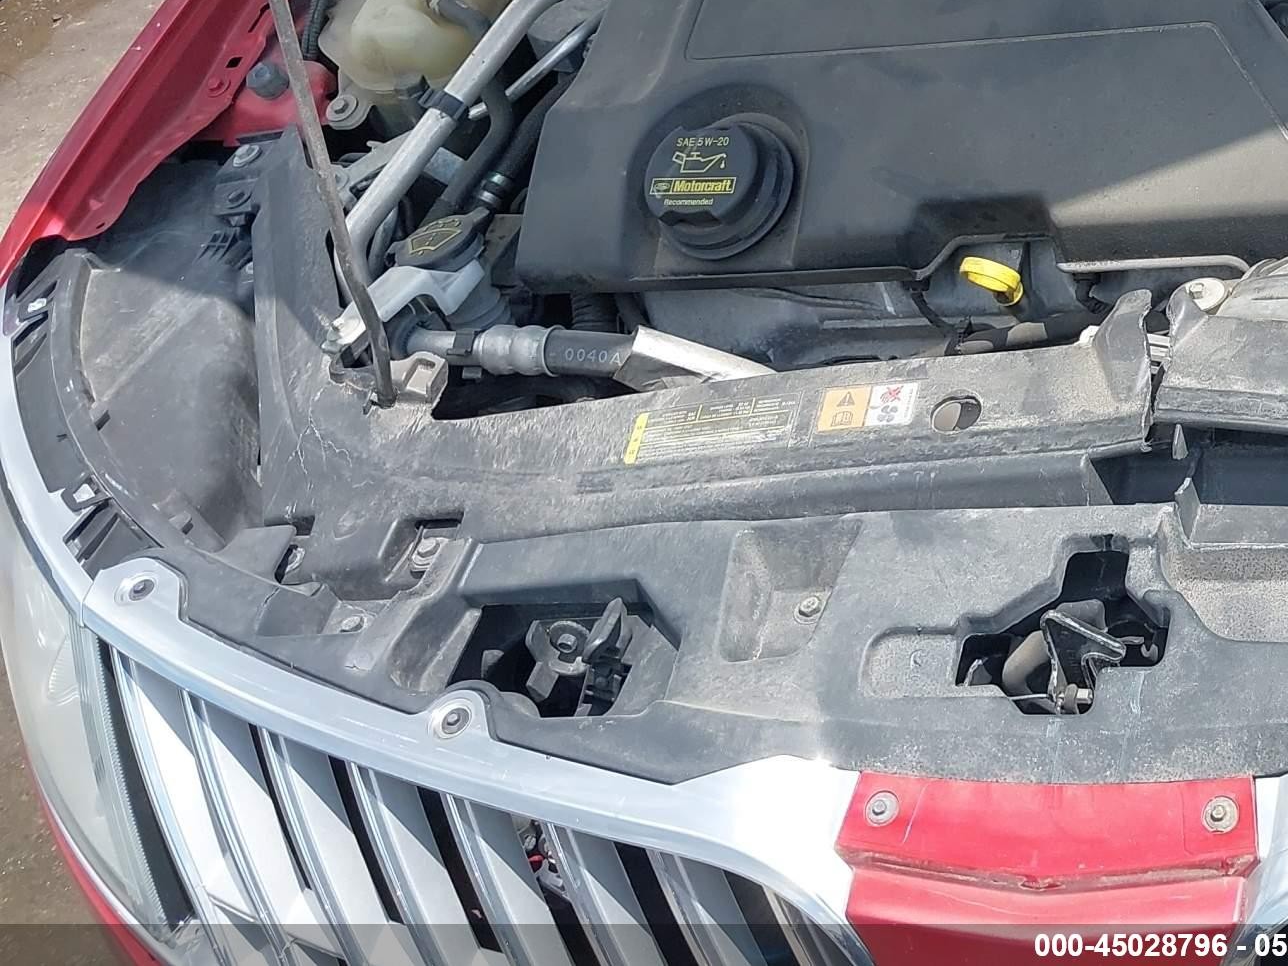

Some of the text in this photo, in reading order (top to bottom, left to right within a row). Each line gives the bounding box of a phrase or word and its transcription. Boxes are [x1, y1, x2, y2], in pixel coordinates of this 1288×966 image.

[676, 136, 730, 147] SAE 5W-20
[674, 180, 732, 192] Motorcraft
[664, 198, 714, 206] Recommended
